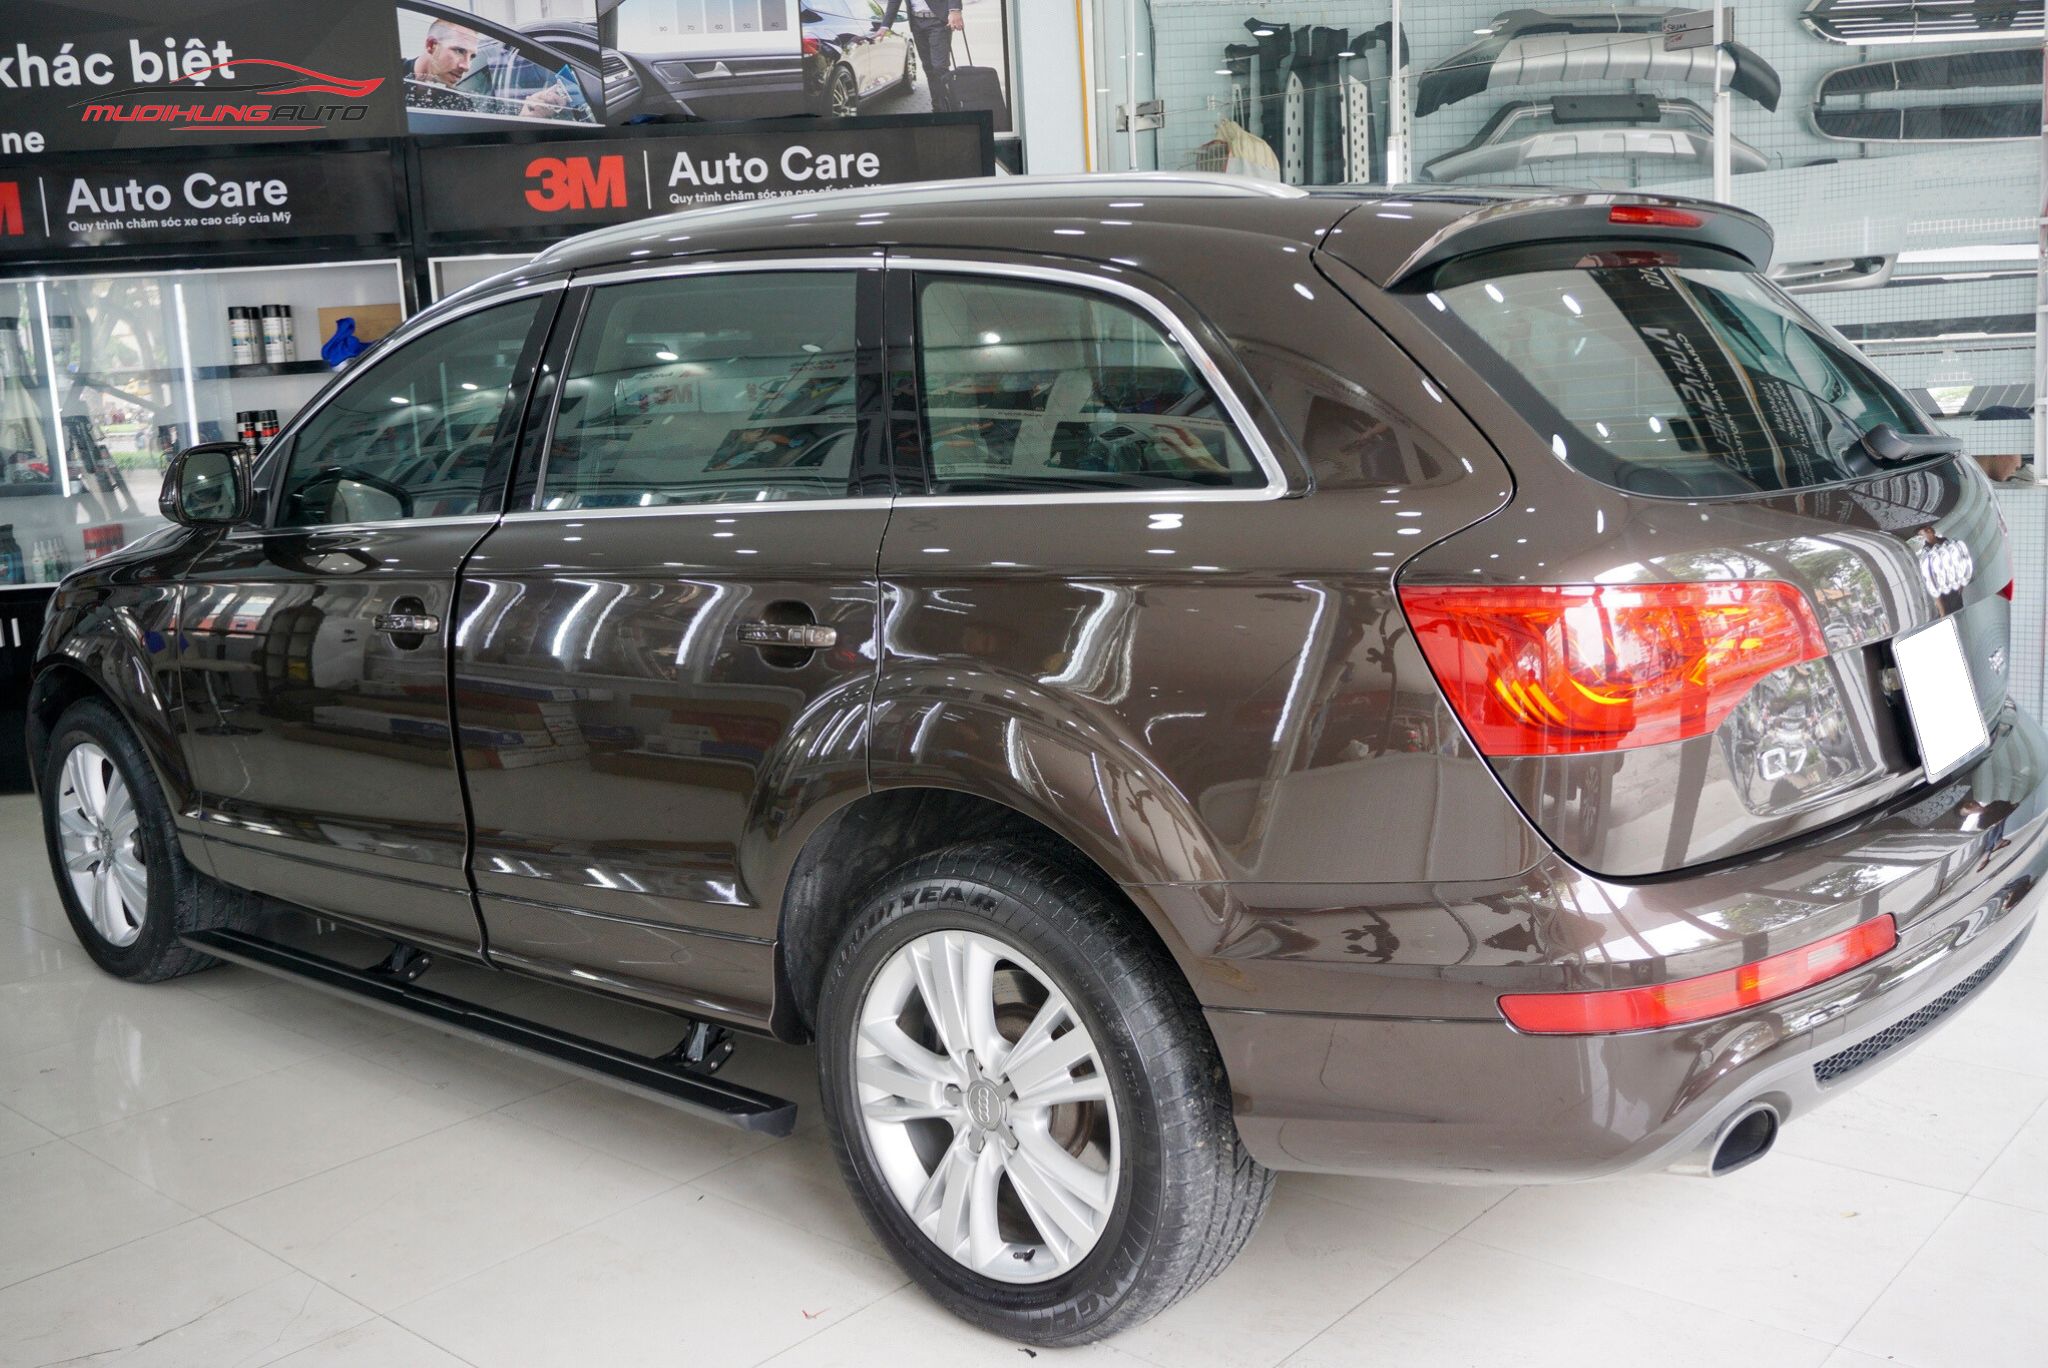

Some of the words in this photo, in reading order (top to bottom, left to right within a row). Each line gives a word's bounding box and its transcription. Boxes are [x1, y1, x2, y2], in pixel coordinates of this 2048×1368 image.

[128, 36, 236, 87] biệt
[66, 178, 172, 215] Auto
[183, 171, 289, 209] Care
[524, 155, 628, 212] 3M
[668, 151, 769, 187] Auto
[780, 145, 880, 183] Care
[669, 193, 693, 206] Quy
[695, 190, 722, 203] trình
[724, 190, 755, 201] chăm
[757, 188, 777, 200] sóc
[68, 220, 94, 233] Quy
[95, 218, 124, 231] trình
[126, 217, 159, 229] chăm
[160, 216, 182, 228] sóc
[184, 217, 199, 227] xe
[200, 216, 223, 226] cao
[224, 212, 246, 227] cấp
[248, 213, 271, 224] của
[272, 211, 292, 225] Mỹ
[1758, 747, 1808, 780] Q7
